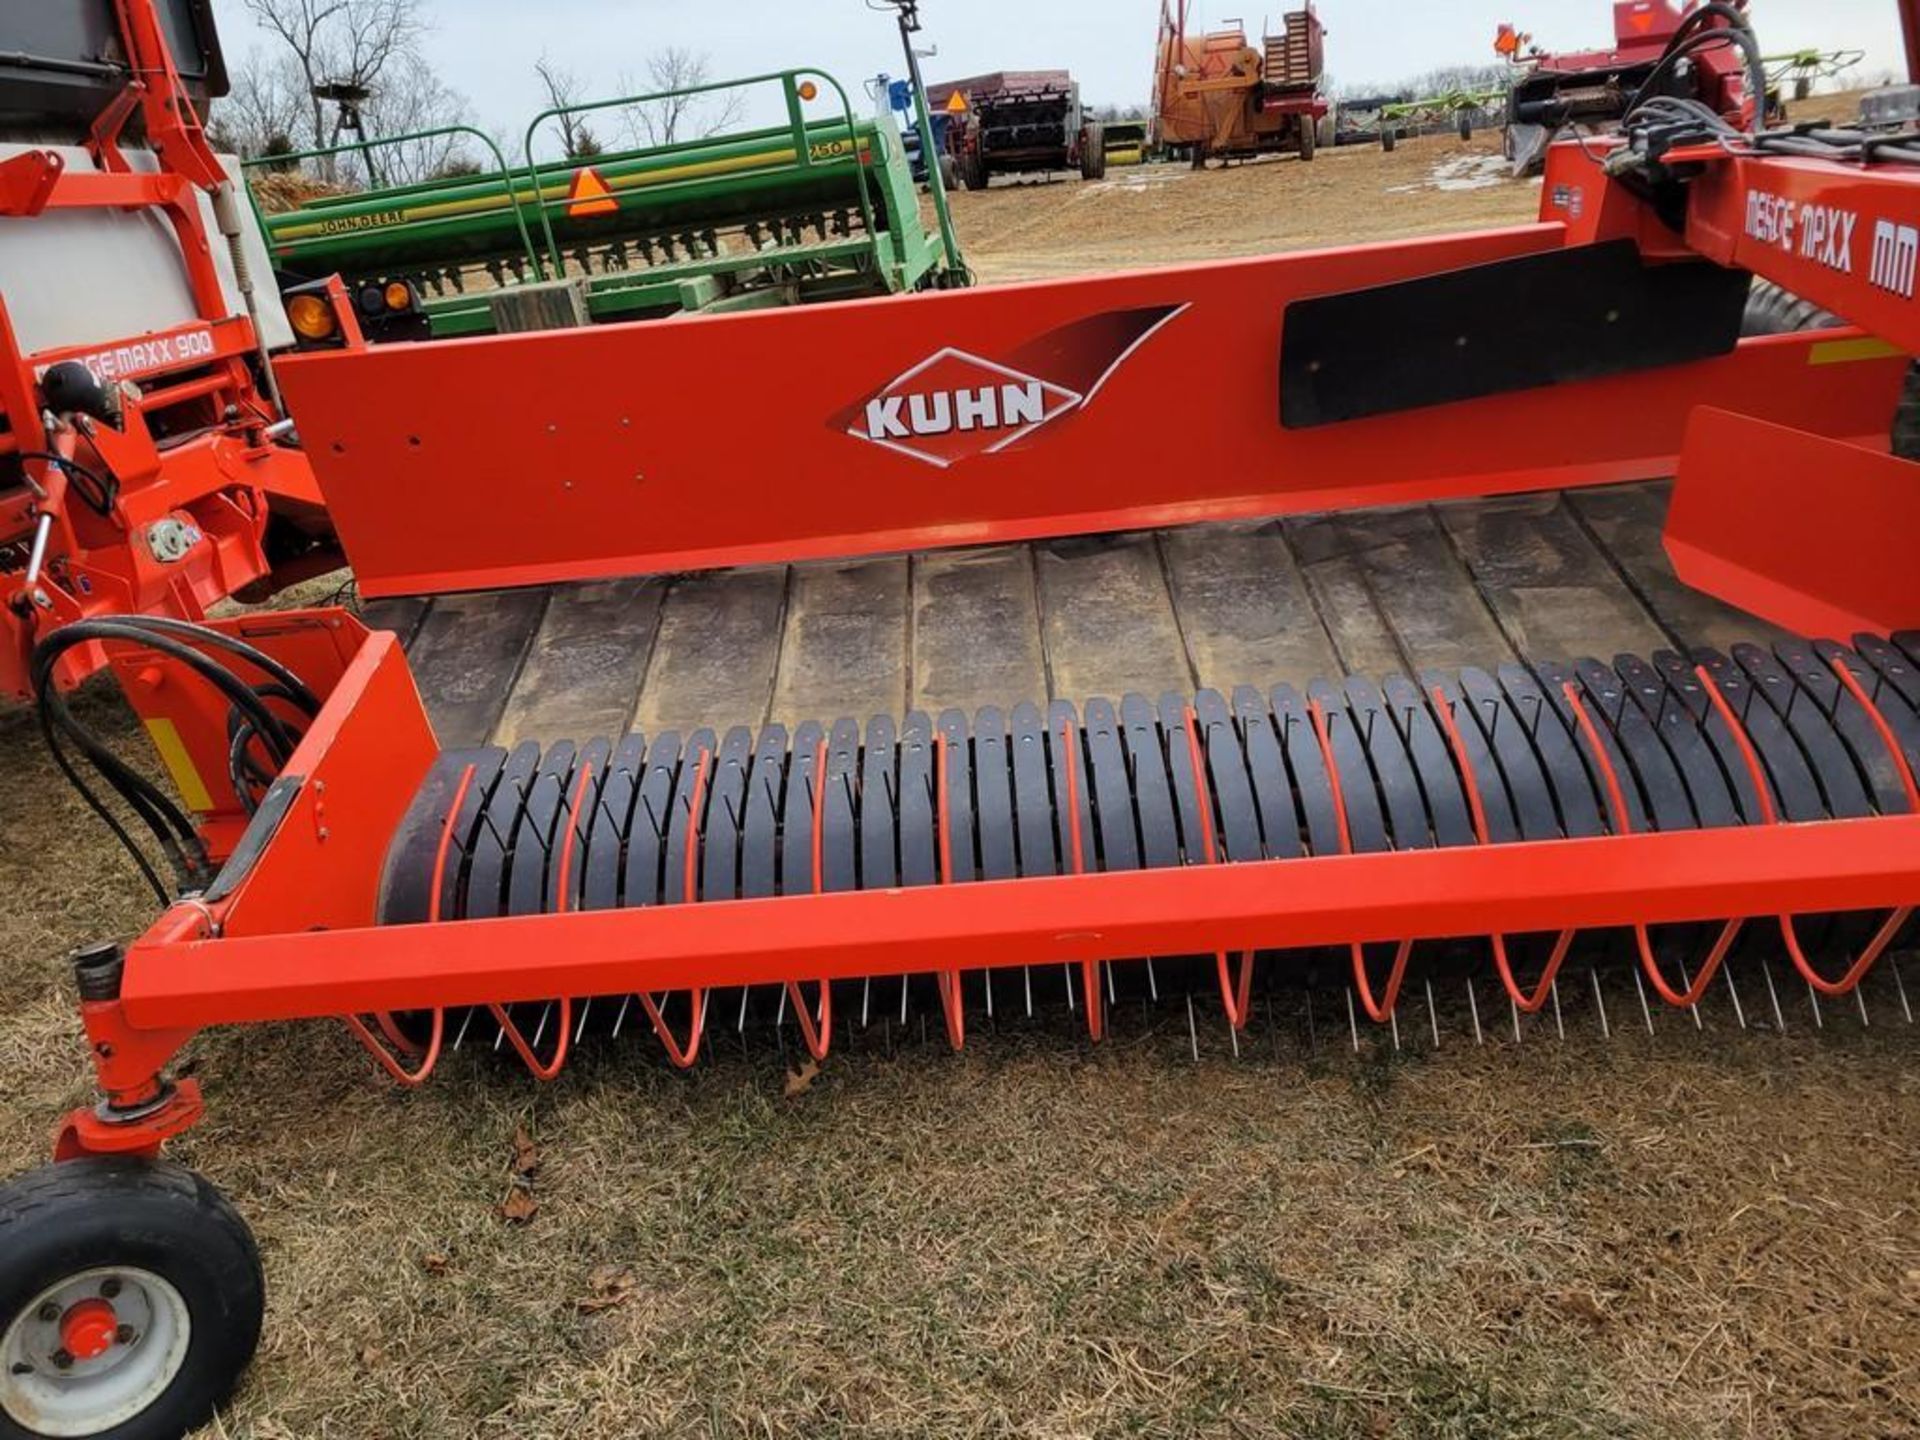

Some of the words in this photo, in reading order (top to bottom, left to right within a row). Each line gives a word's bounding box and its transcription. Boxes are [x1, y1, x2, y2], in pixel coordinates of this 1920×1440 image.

[319, 217, 357, 233] JOHN
[360, 211, 407, 230] DEERE
[115, 337, 174, 375] MAXX
[176, 330, 216, 358] 900
[866, 380, 1044, 438] KUHN
